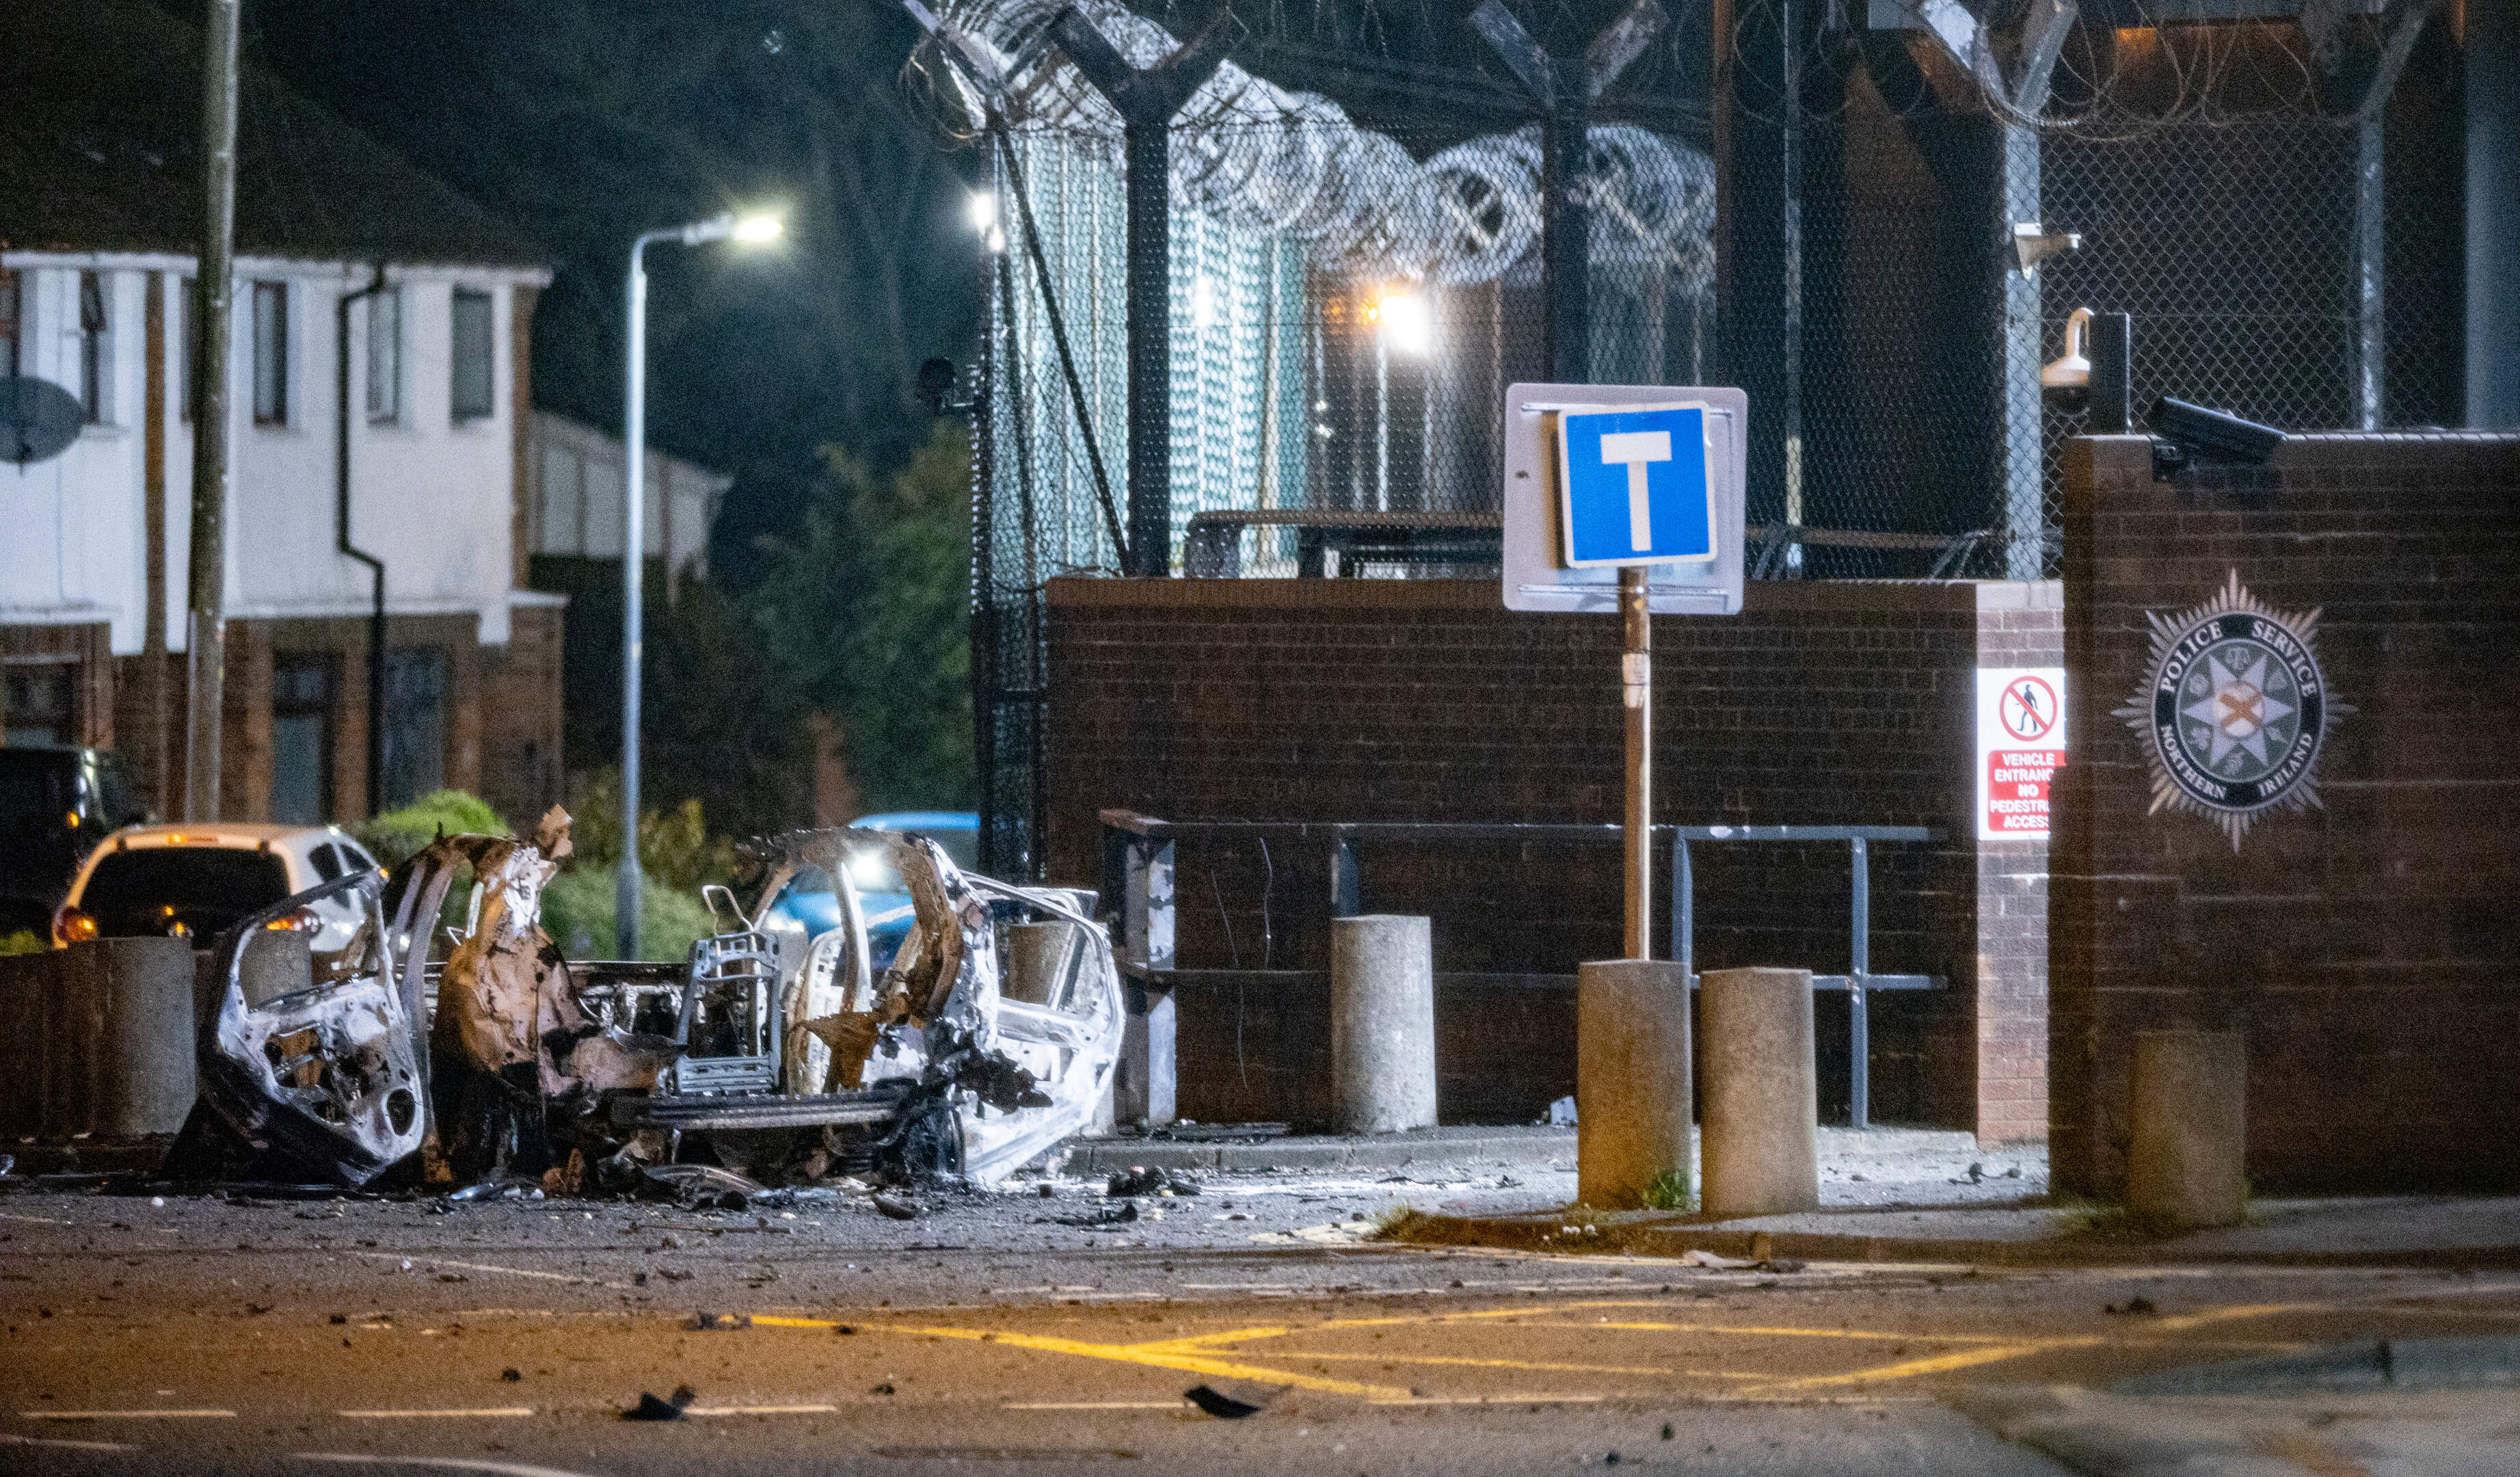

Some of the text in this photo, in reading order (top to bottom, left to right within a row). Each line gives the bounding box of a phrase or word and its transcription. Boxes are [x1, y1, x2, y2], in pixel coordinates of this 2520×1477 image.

[2160, 621, 2317, 697] POLICE SERVICE
[2002, 753, 2055, 766] VEHICLE
[2160, 725, 2227, 799] NORTHERN
[1994, 769, 2054, 782] ENTRANC
[2018, 784, 2039, 797] NO
[1990, 799, 2050, 813] PEDESTRI
